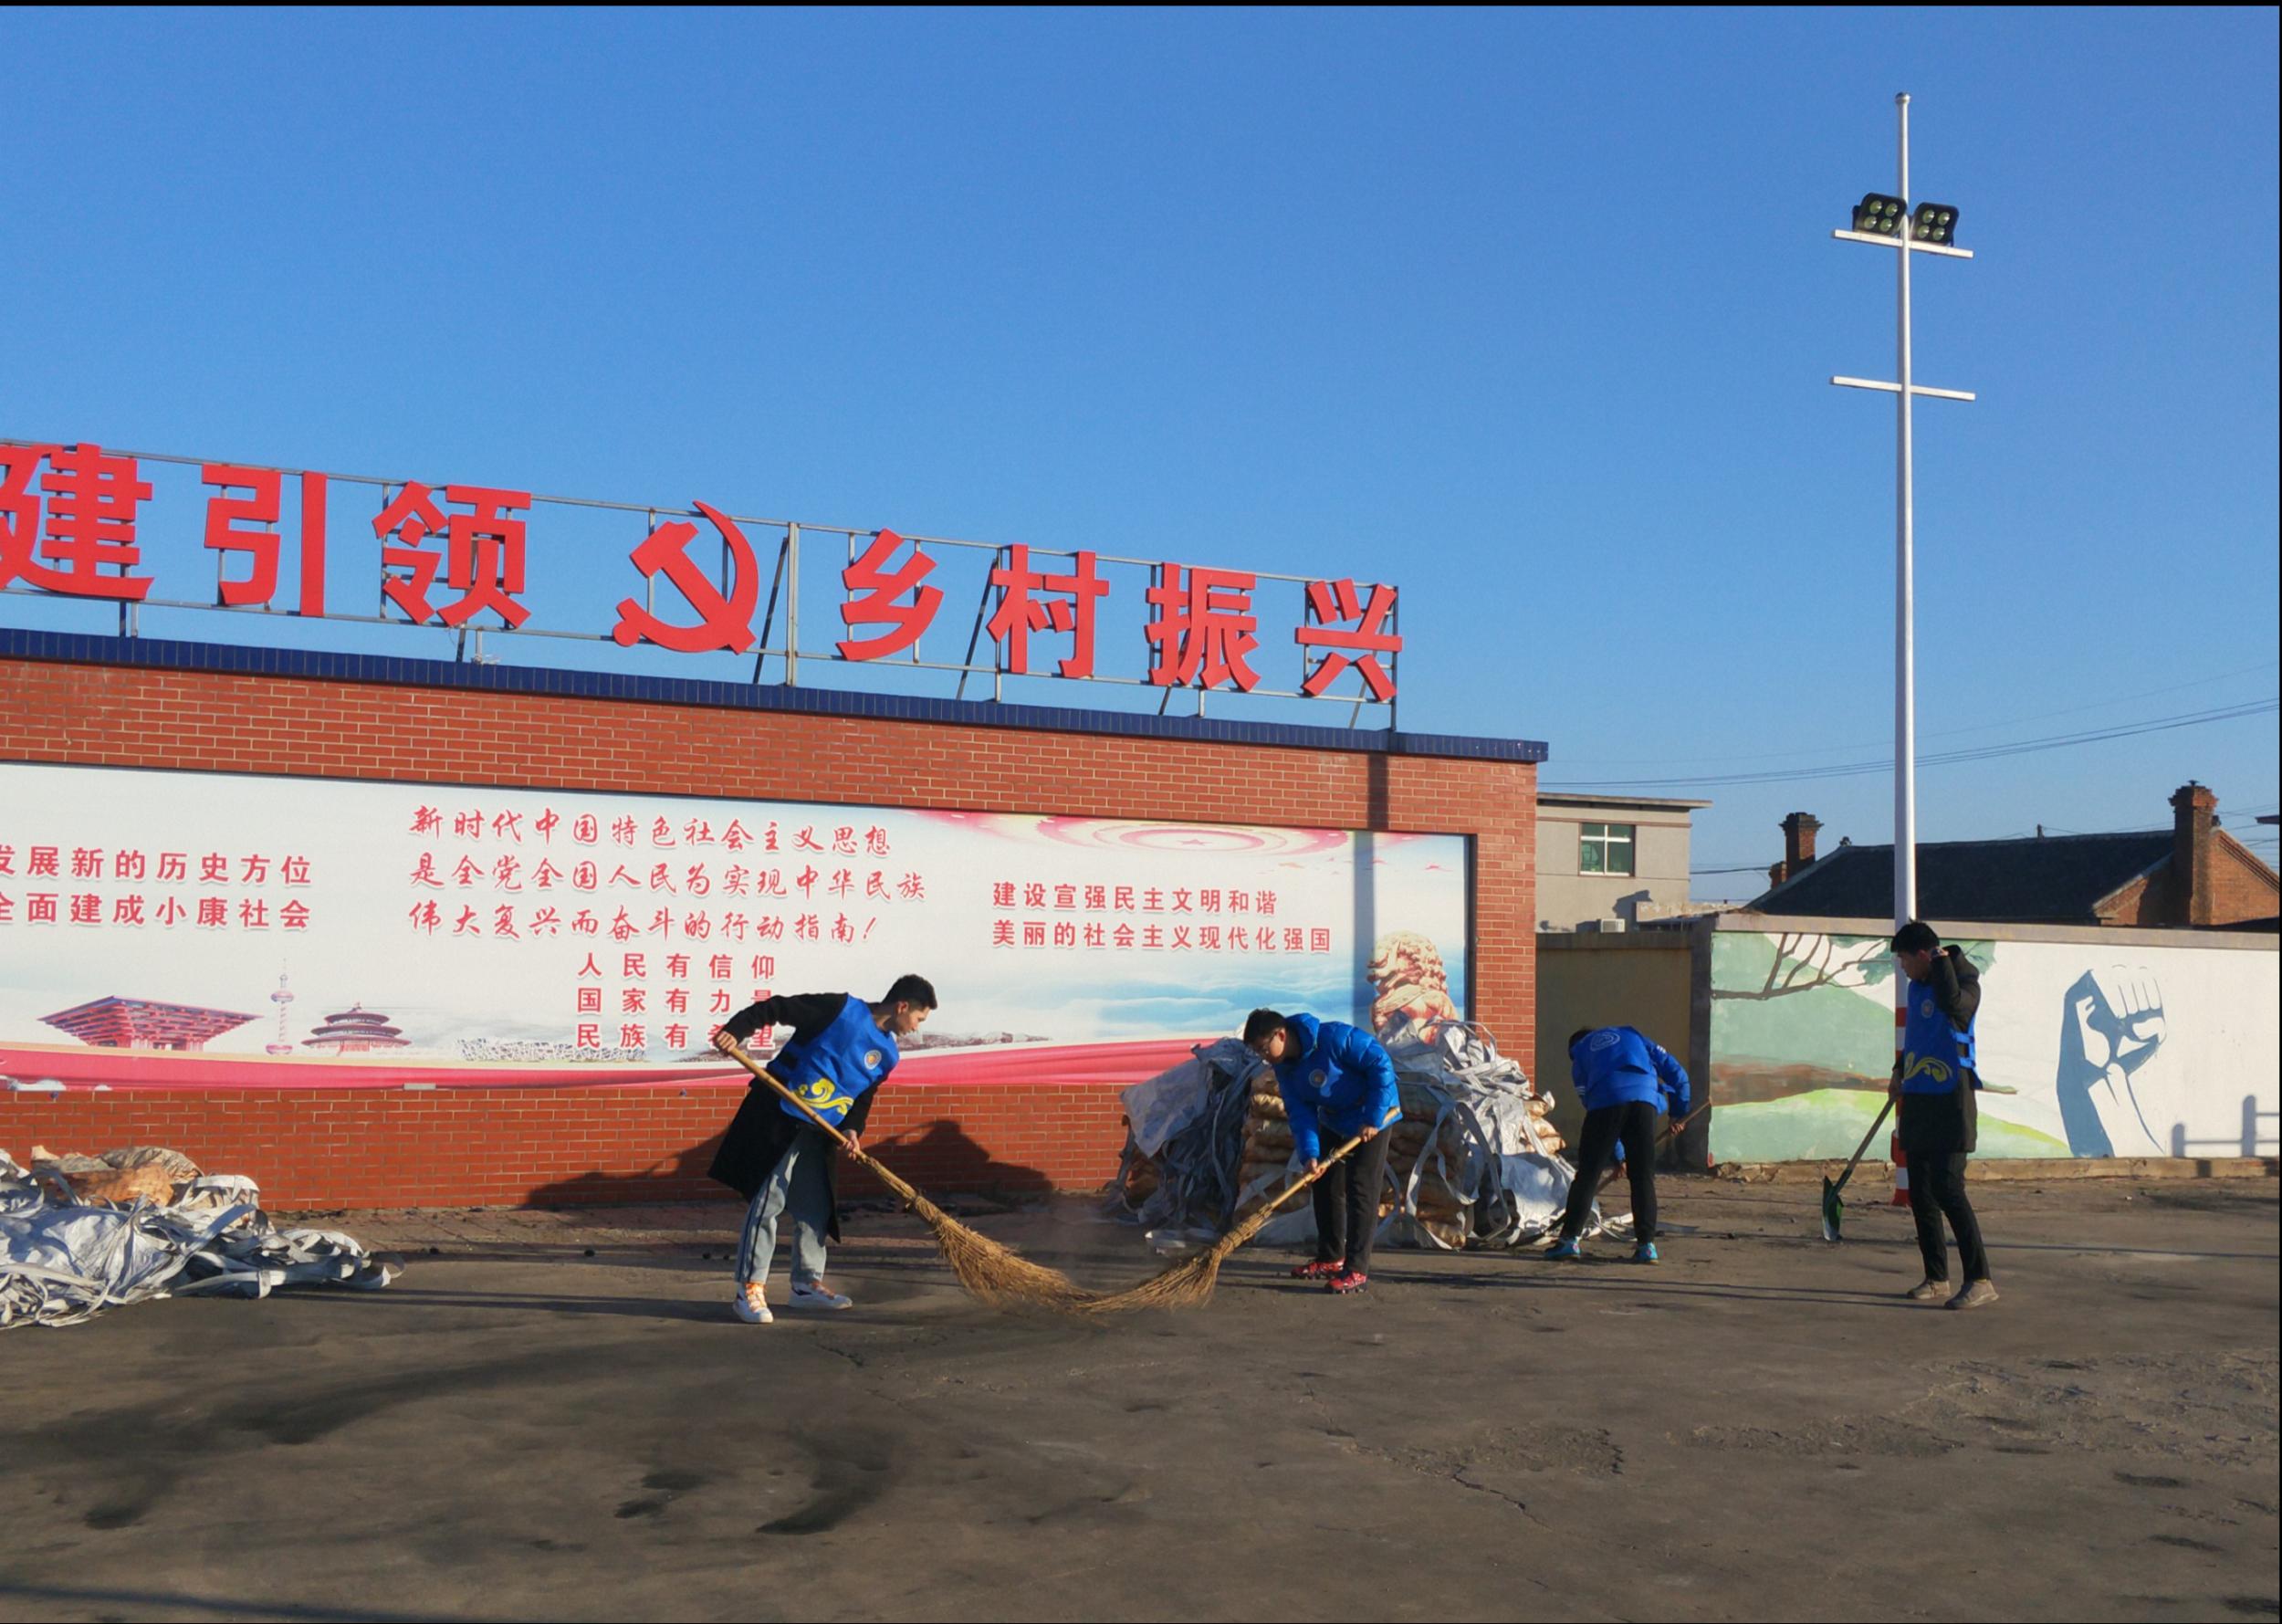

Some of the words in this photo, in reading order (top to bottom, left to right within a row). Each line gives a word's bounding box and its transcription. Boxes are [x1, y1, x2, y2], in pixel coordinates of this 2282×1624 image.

[0, 443, 532, 630] 建引领
[837, 529, 1403, 701] 乡村振兴
[409, 804, 891, 856] 新时代中国特色社会主义思想
[409, 852, 926, 900] 是全党全国人民为实现中华民族
[993, 882, 1277, 915] 建设宣强民主文明和谐
[408, 899, 877, 943] 伟大复兴而奋斗的行动指南!
[993, 919, 1330, 952] 美丽的社会主义现代化强国
[577, 951, 775, 980] 人民有信仰
